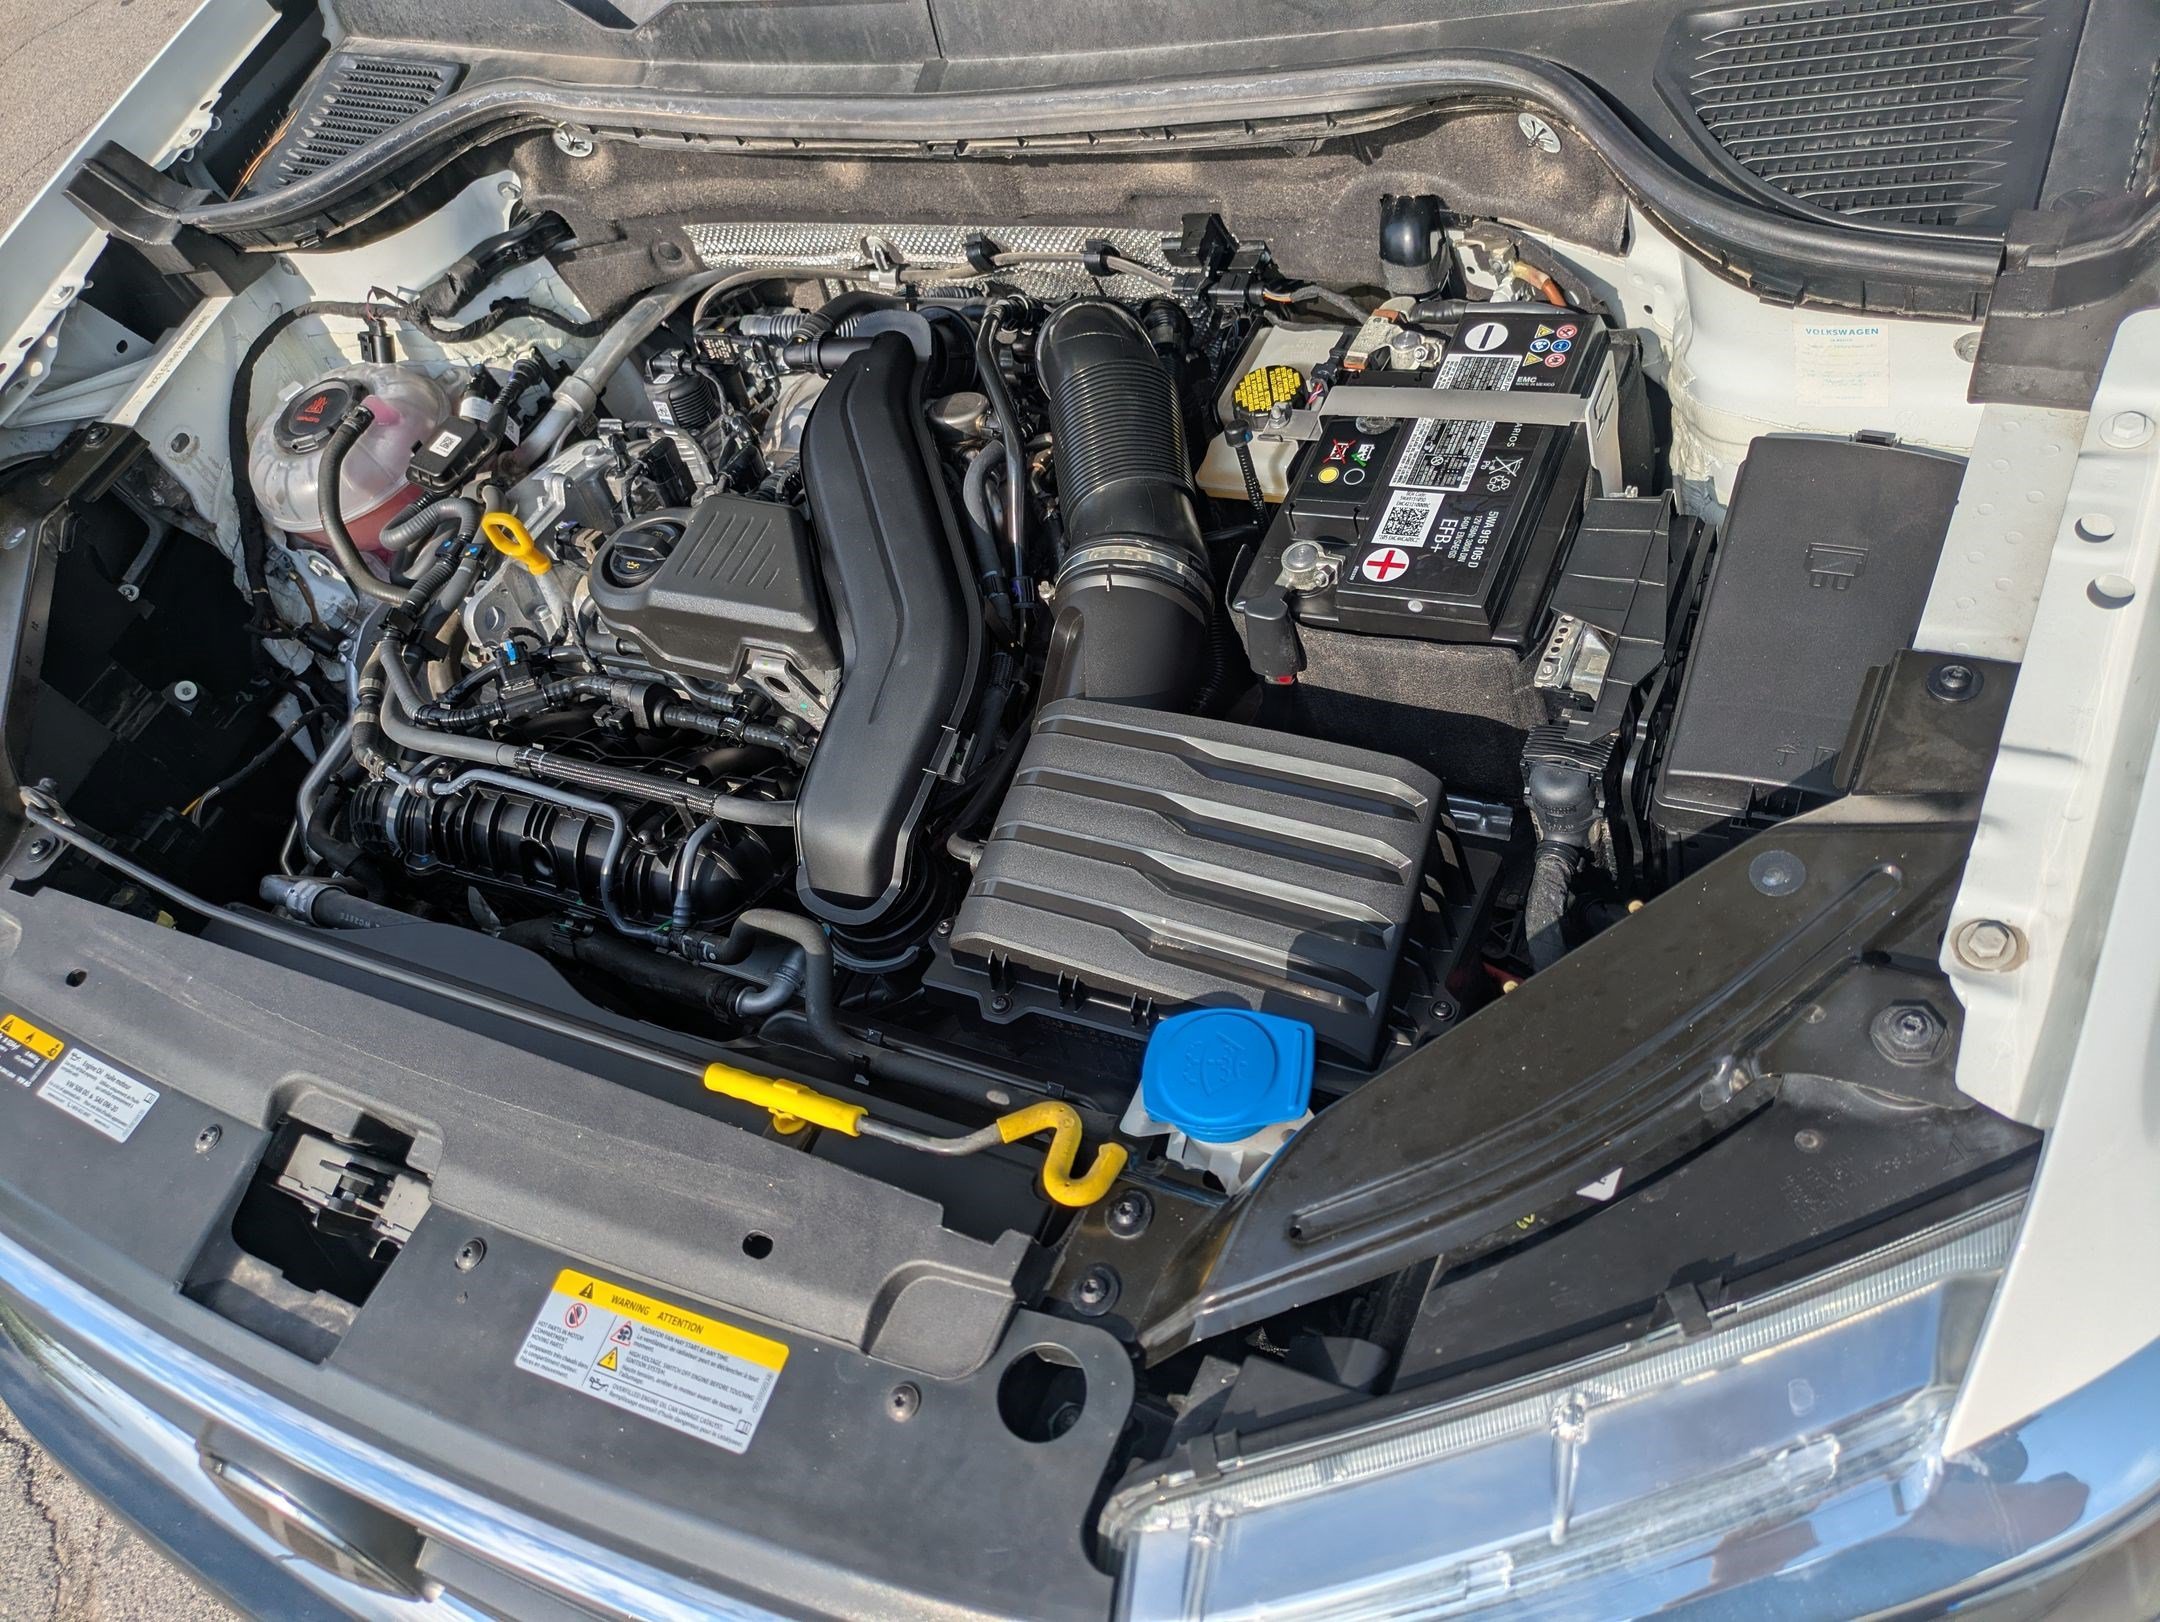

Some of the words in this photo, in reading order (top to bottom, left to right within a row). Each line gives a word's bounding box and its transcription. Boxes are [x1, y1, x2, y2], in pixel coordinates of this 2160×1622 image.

[1805, 327, 1879, 336] VOLKSWAGEN
[1507, 421, 1523, 447] ARIOS
[1480, 461, 1490, 469] Pb
[1459, 516, 1471, 529] 640A
[1473, 515, 1482, 524] 12V
[1483, 511, 1498, 528] 5WA
[1429, 519, 1460, 554] EFB+
[1477, 529, 1491, 544] 915
[1470, 544, 1485, 561] 105
[81, 1060, 98, 1073] Engine
[95, 1067, 104, 1075] Oil
[65, 1079, 75, 1088] VW
[610, 1295, 650, 1315] WARNING
[656, 1311, 704, 1334] ATTENTION
[530, 1333, 549, 1344] MOVING
[547, 1323, 562, 1332] PARTS
[566, 1331, 584, 1341] MOTOR
[639, 1325, 664, 1338] RADIATOR
[663, 1334, 674, 1342] FAN
[674, 1337, 684, 1345] MAY
[684, 1341, 700, 1351] START
[705, 1349, 717, 1357] ANY
[628, 1349, 641, 1358] HIGH
[662, 1362, 681, 1373] SWITCH
[680, 1369, 691, 1377] OFF
[690, 1372, 709, 1383] ENGINE
[708, 1379, 729, 1391] BEFORE
[611, 1383, 641, 1399] OVERFILLED
[640, 1394, 659, 1406] ENGINE
[658, 1401, 667, 1409] OIL
